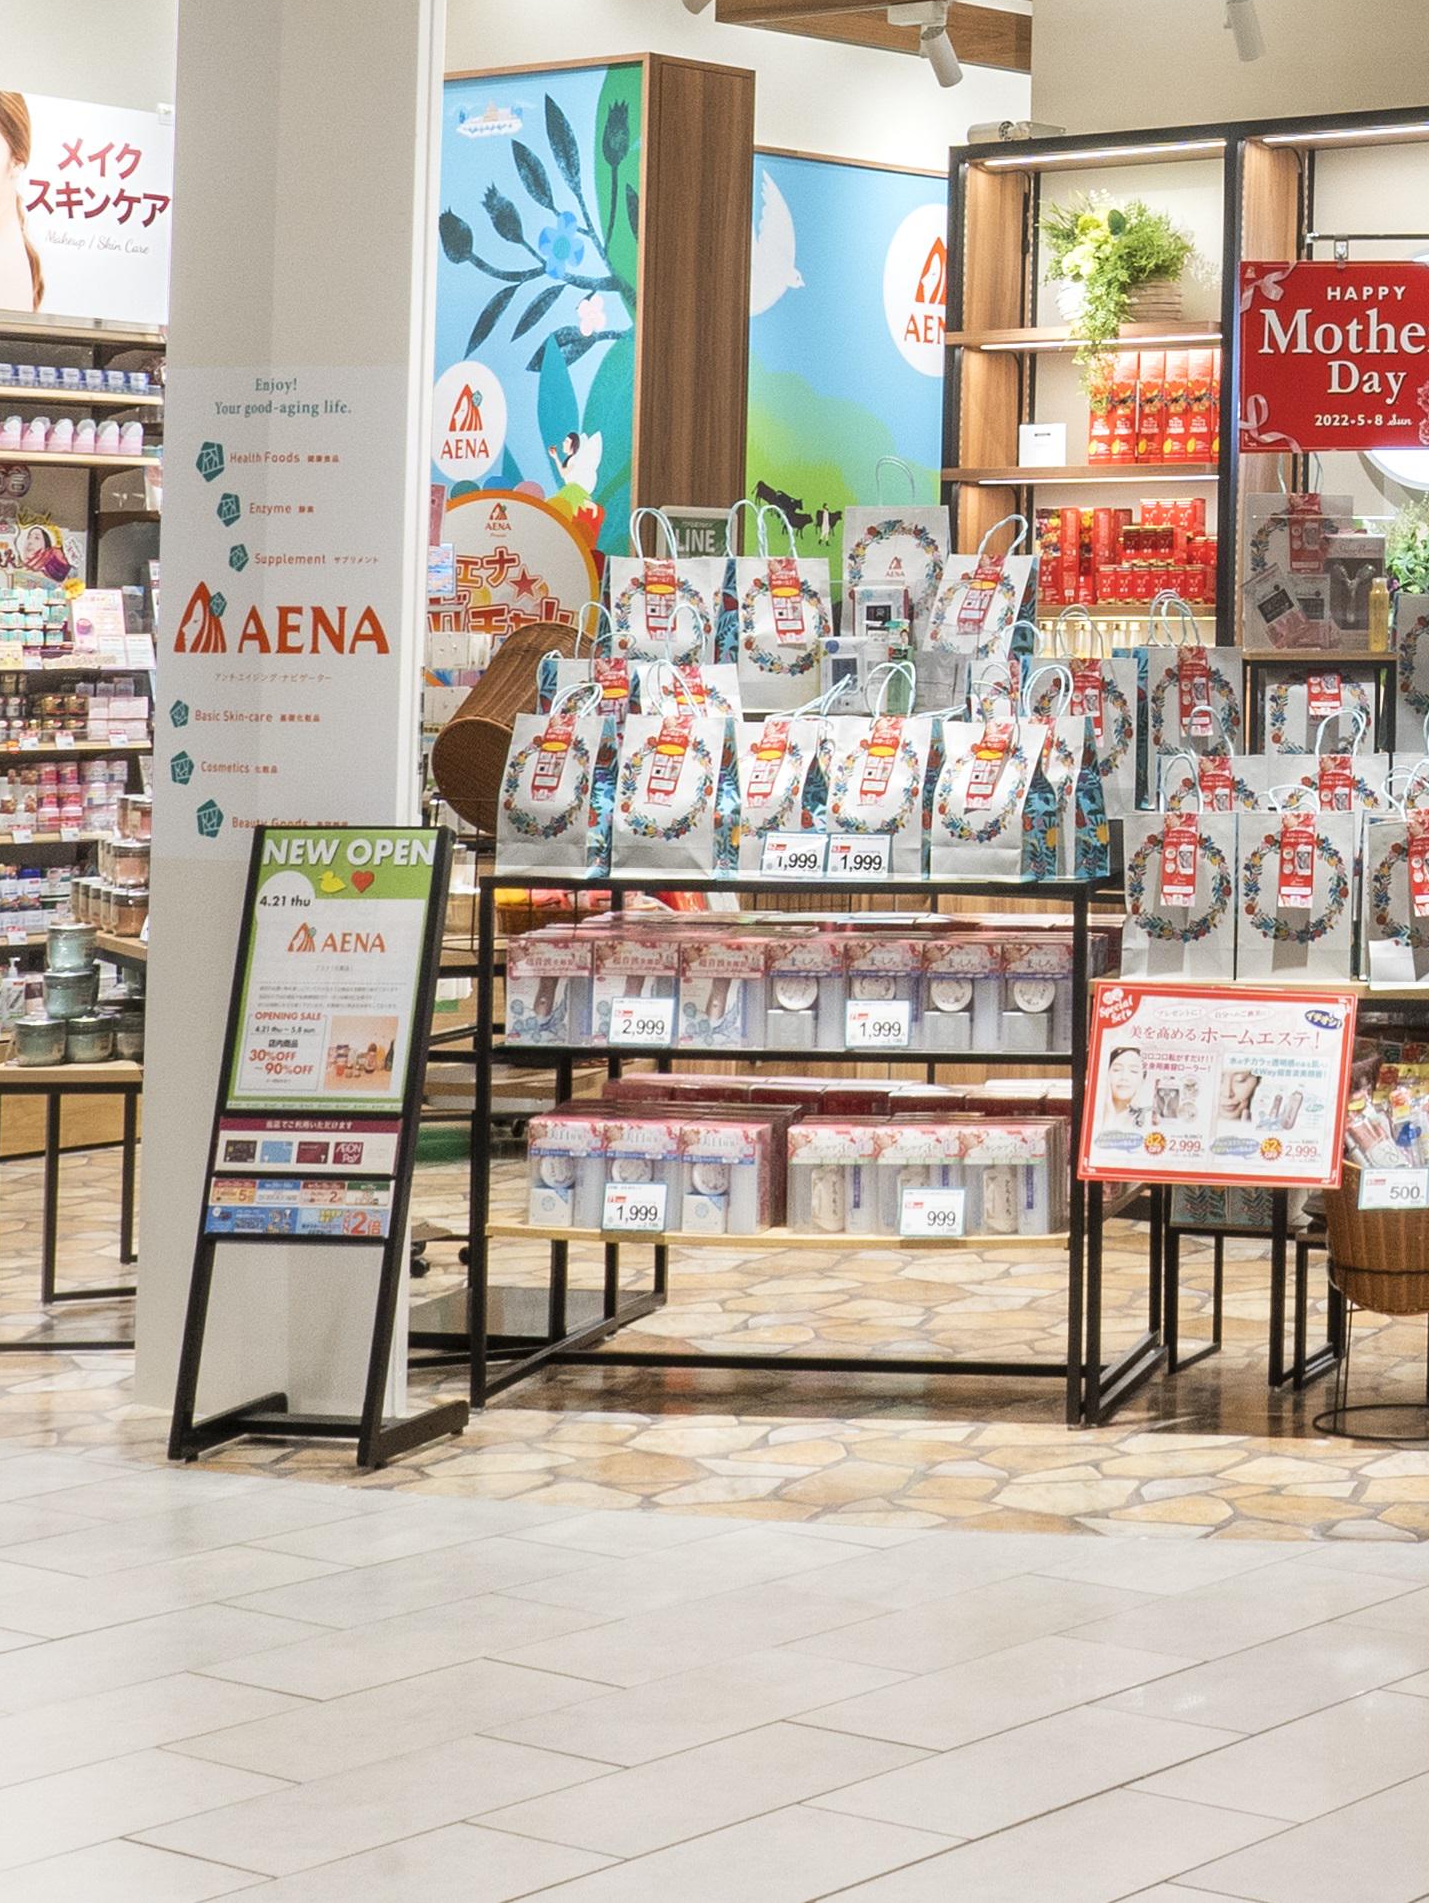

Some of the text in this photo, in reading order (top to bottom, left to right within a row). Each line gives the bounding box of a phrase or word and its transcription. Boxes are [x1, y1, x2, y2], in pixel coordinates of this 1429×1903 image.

[57, 137, 142, 180] メイク
[25, 178, 172, 229] スキンケア
[1326, 286, 1407, 301] HAPPY
[254, 377, 297, 395] Enjoy!
[1326, 359, 1408, 405] Day
[215, 400, 352, 418] Your good-aging life.
[1386, 413, 1413, 426] Sun
[229, 451, 261, 463] Health
[264, 450, 301, 463] Foods
[440, 438, 490, 460] AENA
[249, 502, 292, 516] Enzyme
[484, 521, 512, 531] AENA
[674, 528, 717, 550] LINE
[254, 552, 326, 566] Supplement
[237, 604, 391, 655] AENA
[194, 709, 221, 722] Basic
[223, 710, 274, 723] Skin-care
[200, 761, 250, 774] Cosmetics
[262, 838, 438, 866] NEW OPEN
[776, 853, 818, 871] 1,999
[840, 854, 883, 871] 1,999
[259, 894, 311, 907] 4.21 thu
[321, 932, 386, 954] AENA
[1099, 995, 1134, 1018] Special
[254, 1011, 322, 1021] OPENING SALE
[622, 1018, 666, 1037] 2,999
[860, 1021, 902, 1039] 1,999
[1129, 1026, 1321, 1050] 美を高めるホームエステ!
[249, 1049, 296, 1062] 30%OFF
[1169, 1138, 1202, 1154] 2,999
[1285, 1144, 1319, 1158] 2,999
[1390, 1185, 1421, 1200] 500
[615, 1205, 660, 1223] 1,999
[926, 1210, 957, 1227] 999
